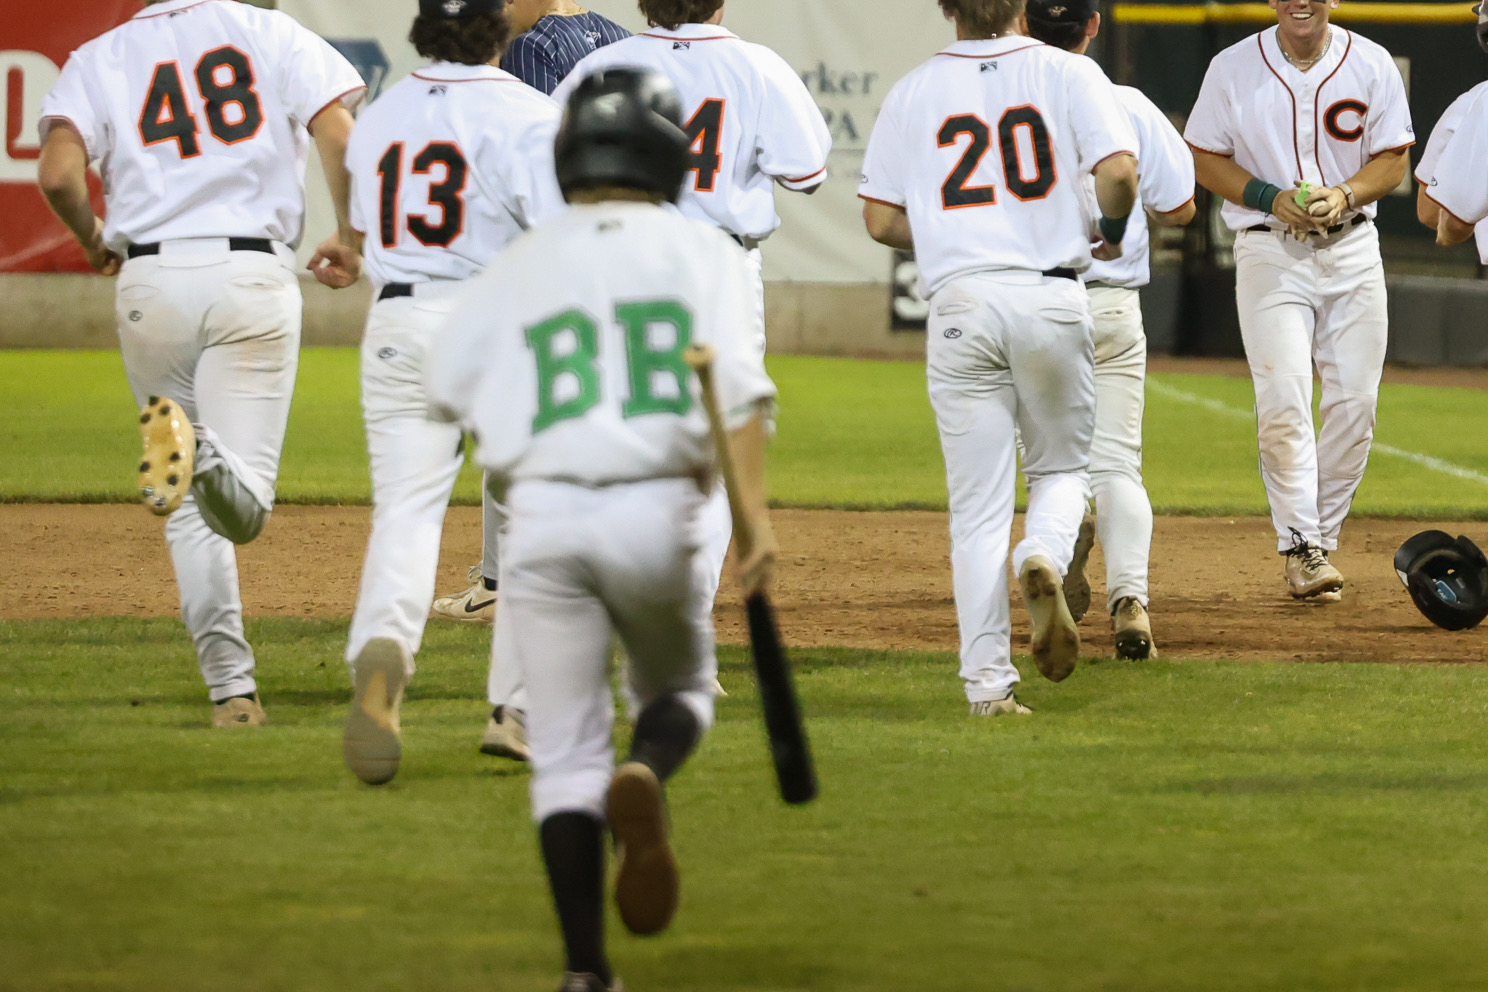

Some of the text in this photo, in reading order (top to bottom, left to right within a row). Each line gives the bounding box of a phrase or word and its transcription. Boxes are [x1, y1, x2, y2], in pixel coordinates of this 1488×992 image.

[138, 44, 265, 159] 48
[936, 103, 1058, 210] 20
[1322, 98, 1369, 142] C
[377, 139, 470, 249] 13
[524, 299, 695, 435] BB
